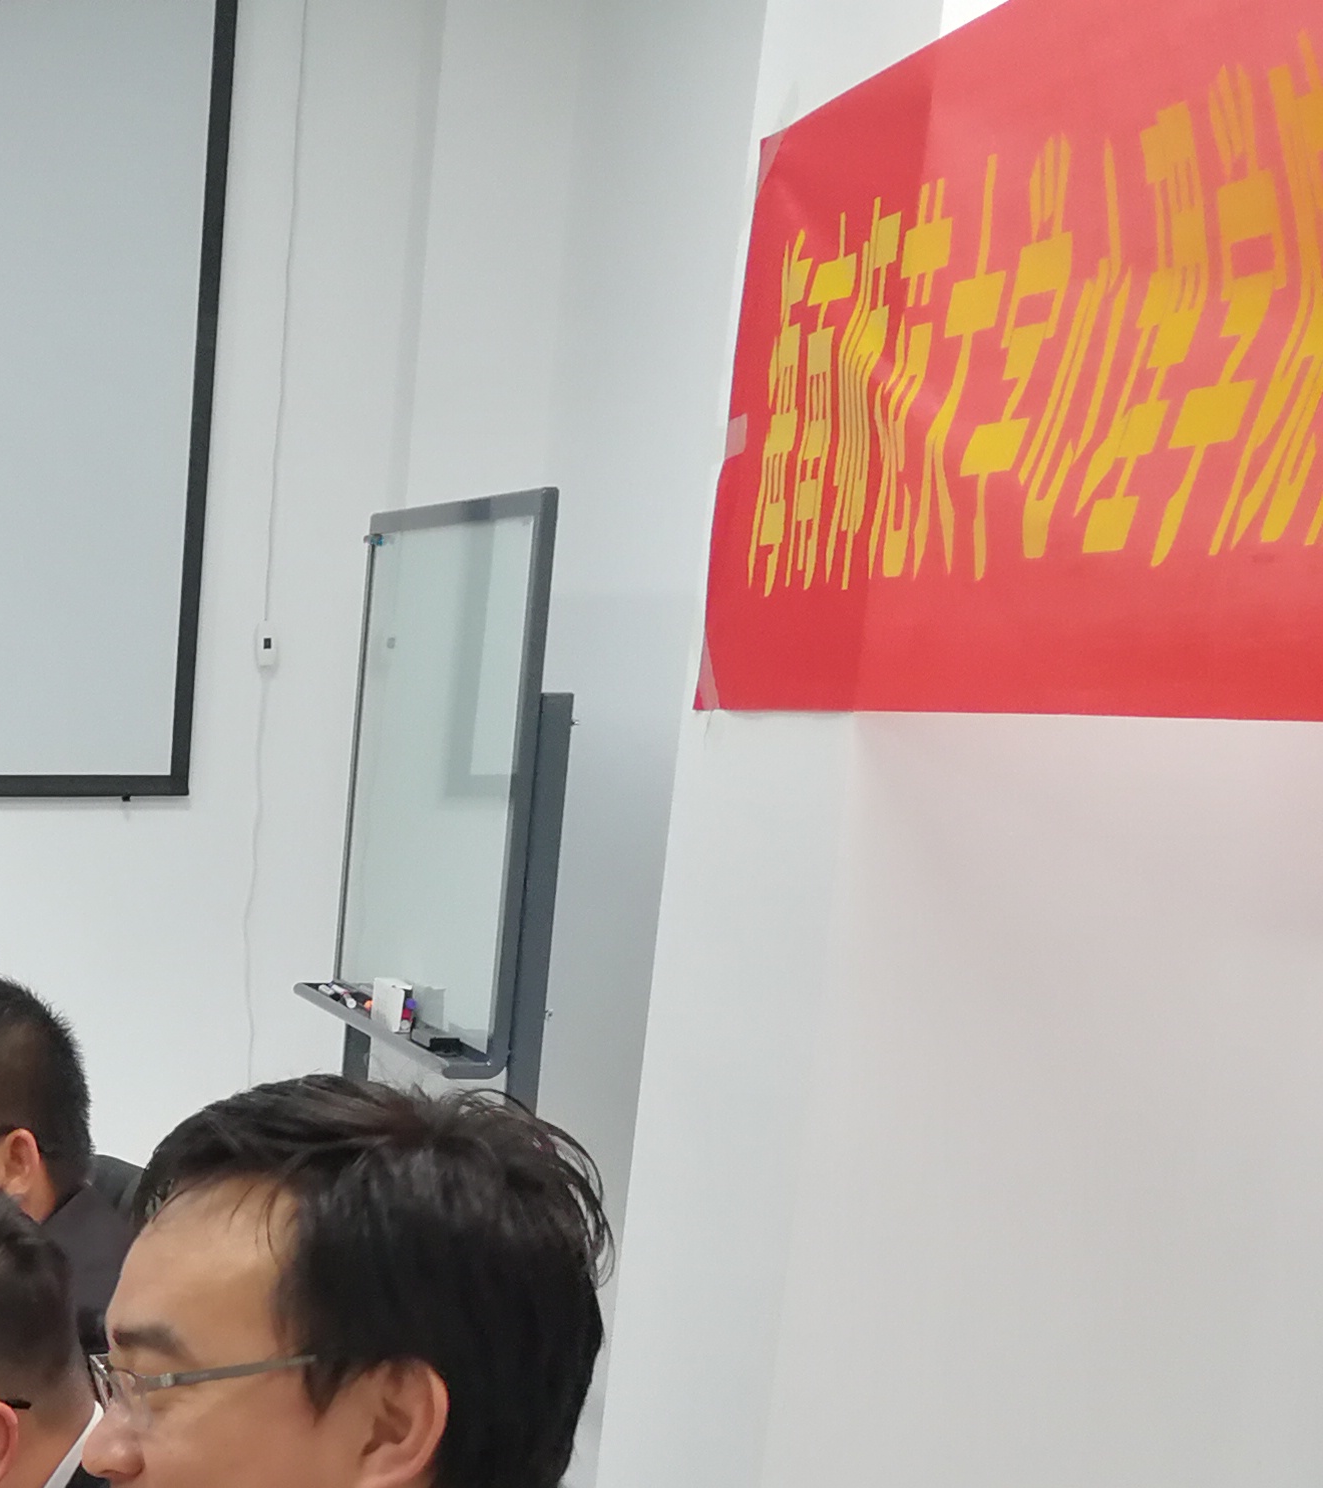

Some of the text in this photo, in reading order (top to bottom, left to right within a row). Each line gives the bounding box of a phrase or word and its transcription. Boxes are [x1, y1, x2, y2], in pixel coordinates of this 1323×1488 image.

[746, 28, 1323, 598] 海南师范大学心理学院
